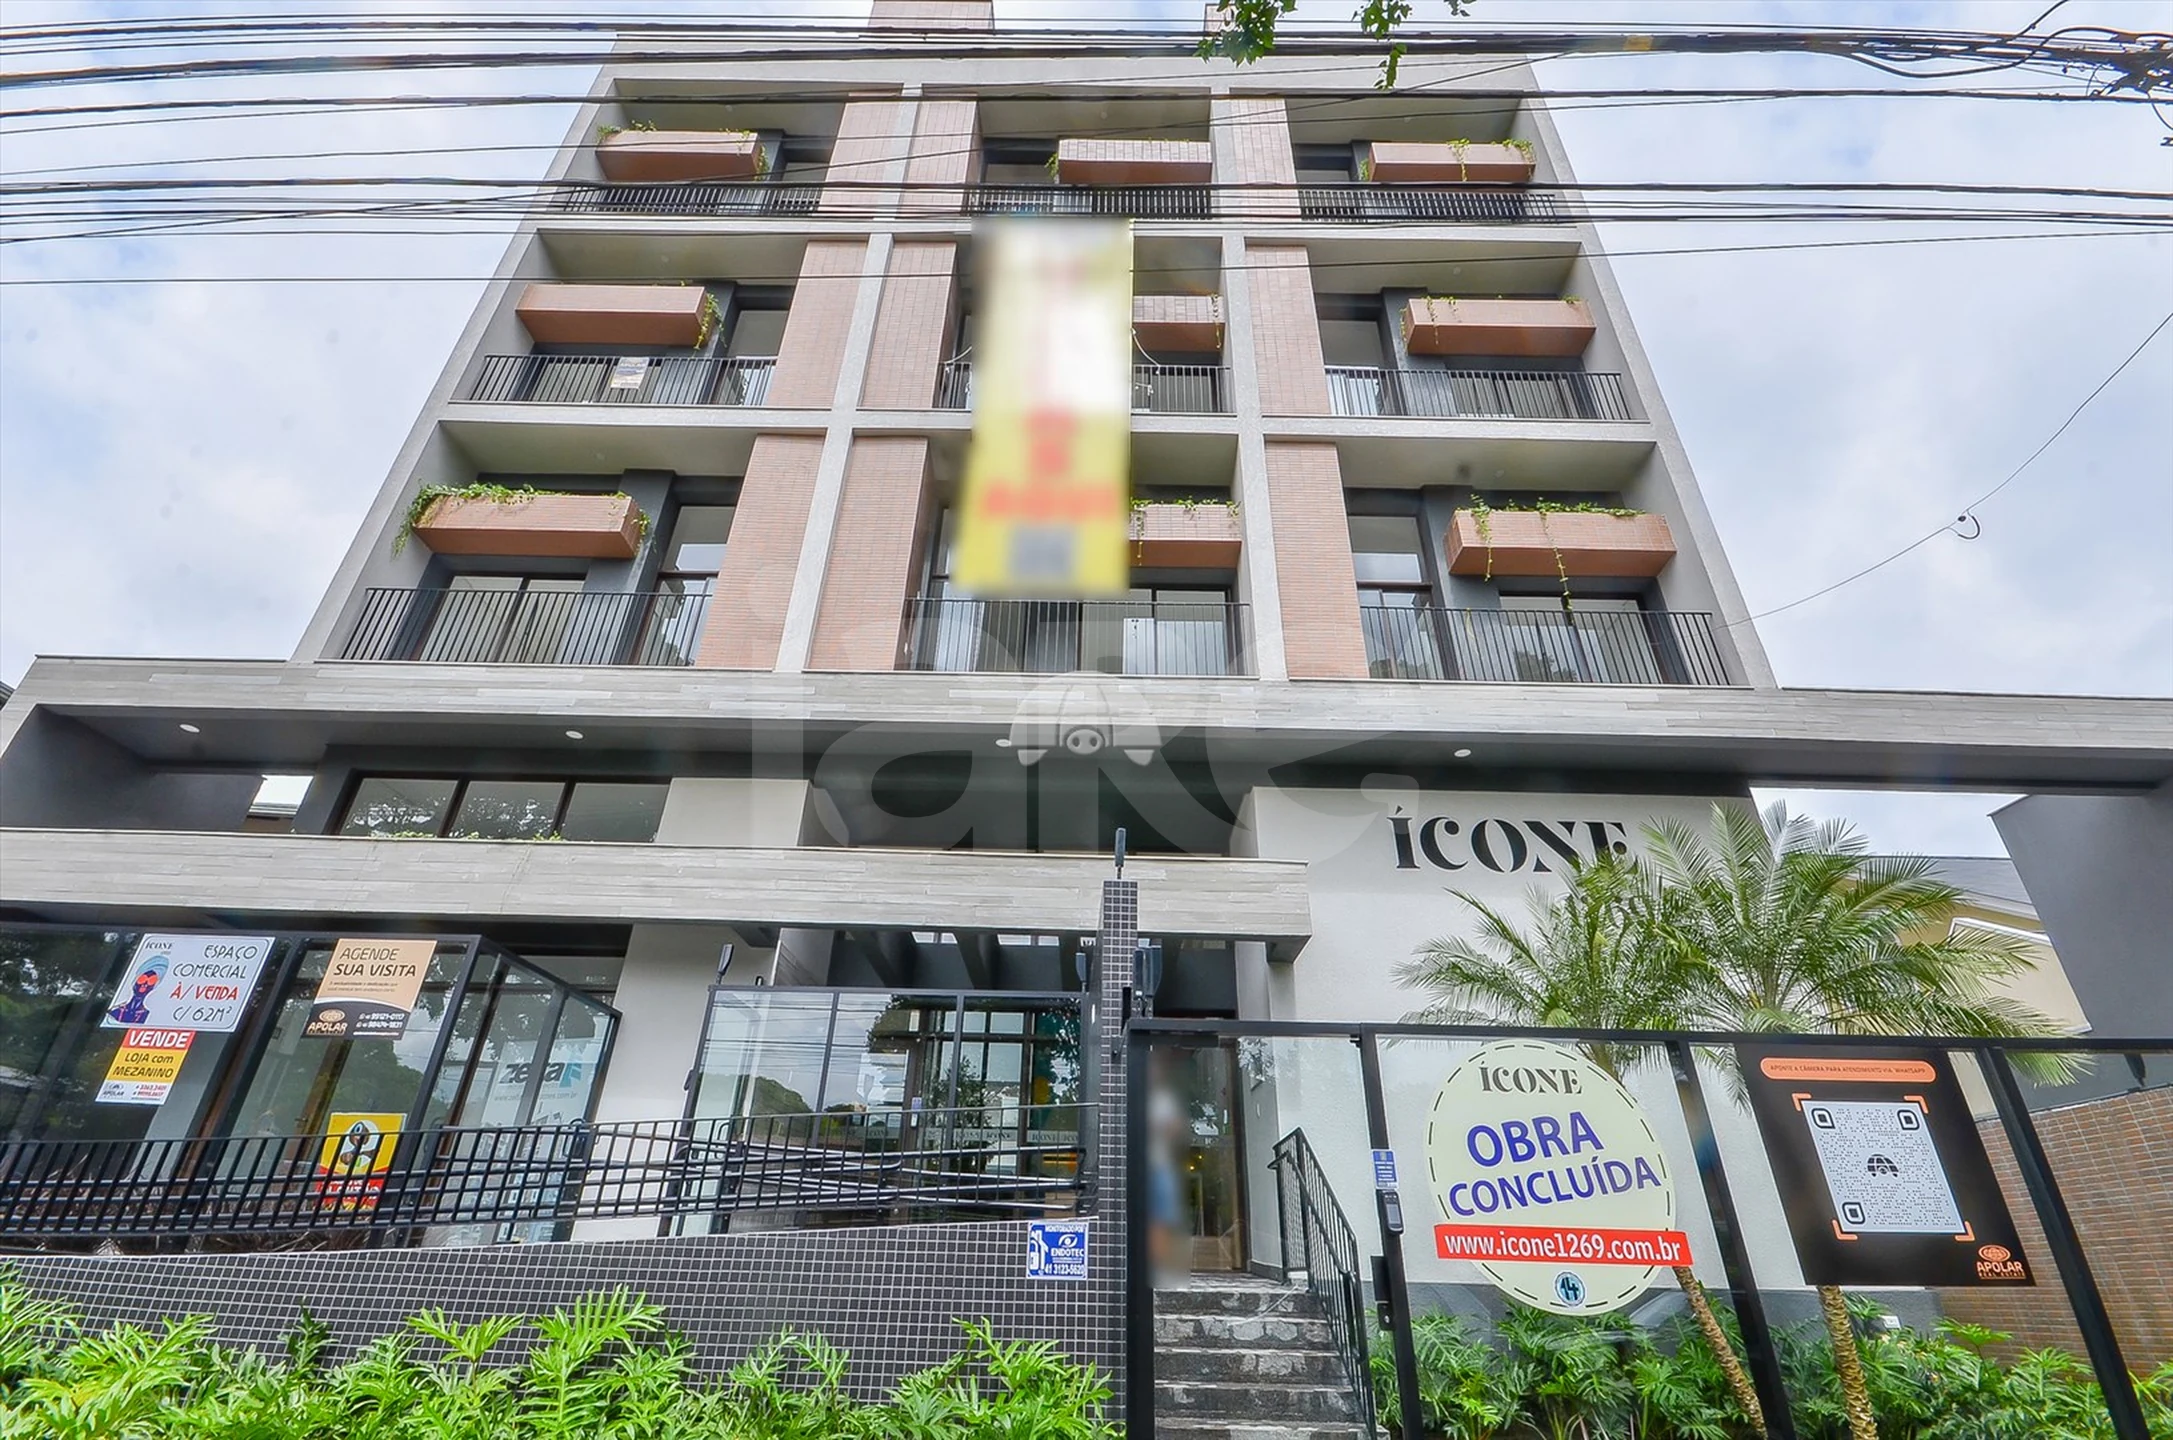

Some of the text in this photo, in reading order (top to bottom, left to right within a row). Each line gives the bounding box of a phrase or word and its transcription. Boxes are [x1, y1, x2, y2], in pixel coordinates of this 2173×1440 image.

[1387, 805, 1639, 874] ÍCONE
[204, 944, 258, 962] ESPAÇO
[339, 947, 400, 961] AGENDE
[172, 963, 246, 979] COMERCIAL
[333, 963, 416, 977] SUA VISITA
[195, 984, 239, 1000] VENDA
[307, 1022, 348, 1032] APOLAR
[128, 1030, 191, 1048] VENDE
[124, 1052, 174, 1065] LOJA com
[112, 1066, 174, 1078] MEZANINO
[1478, 1060, 1583, 1095] ÍCONE
[1466, 1111, 1604, 1168] OBRA
[1450, 1156, 1662, 1217] CONCLUÍDA
[1051, 1248, 1084, 1257] ENDOTEC
[1444, 1230, 1681, 1261] www.icone1269.com.br
[1976, 1261, 2025, 1273] APOLAR
